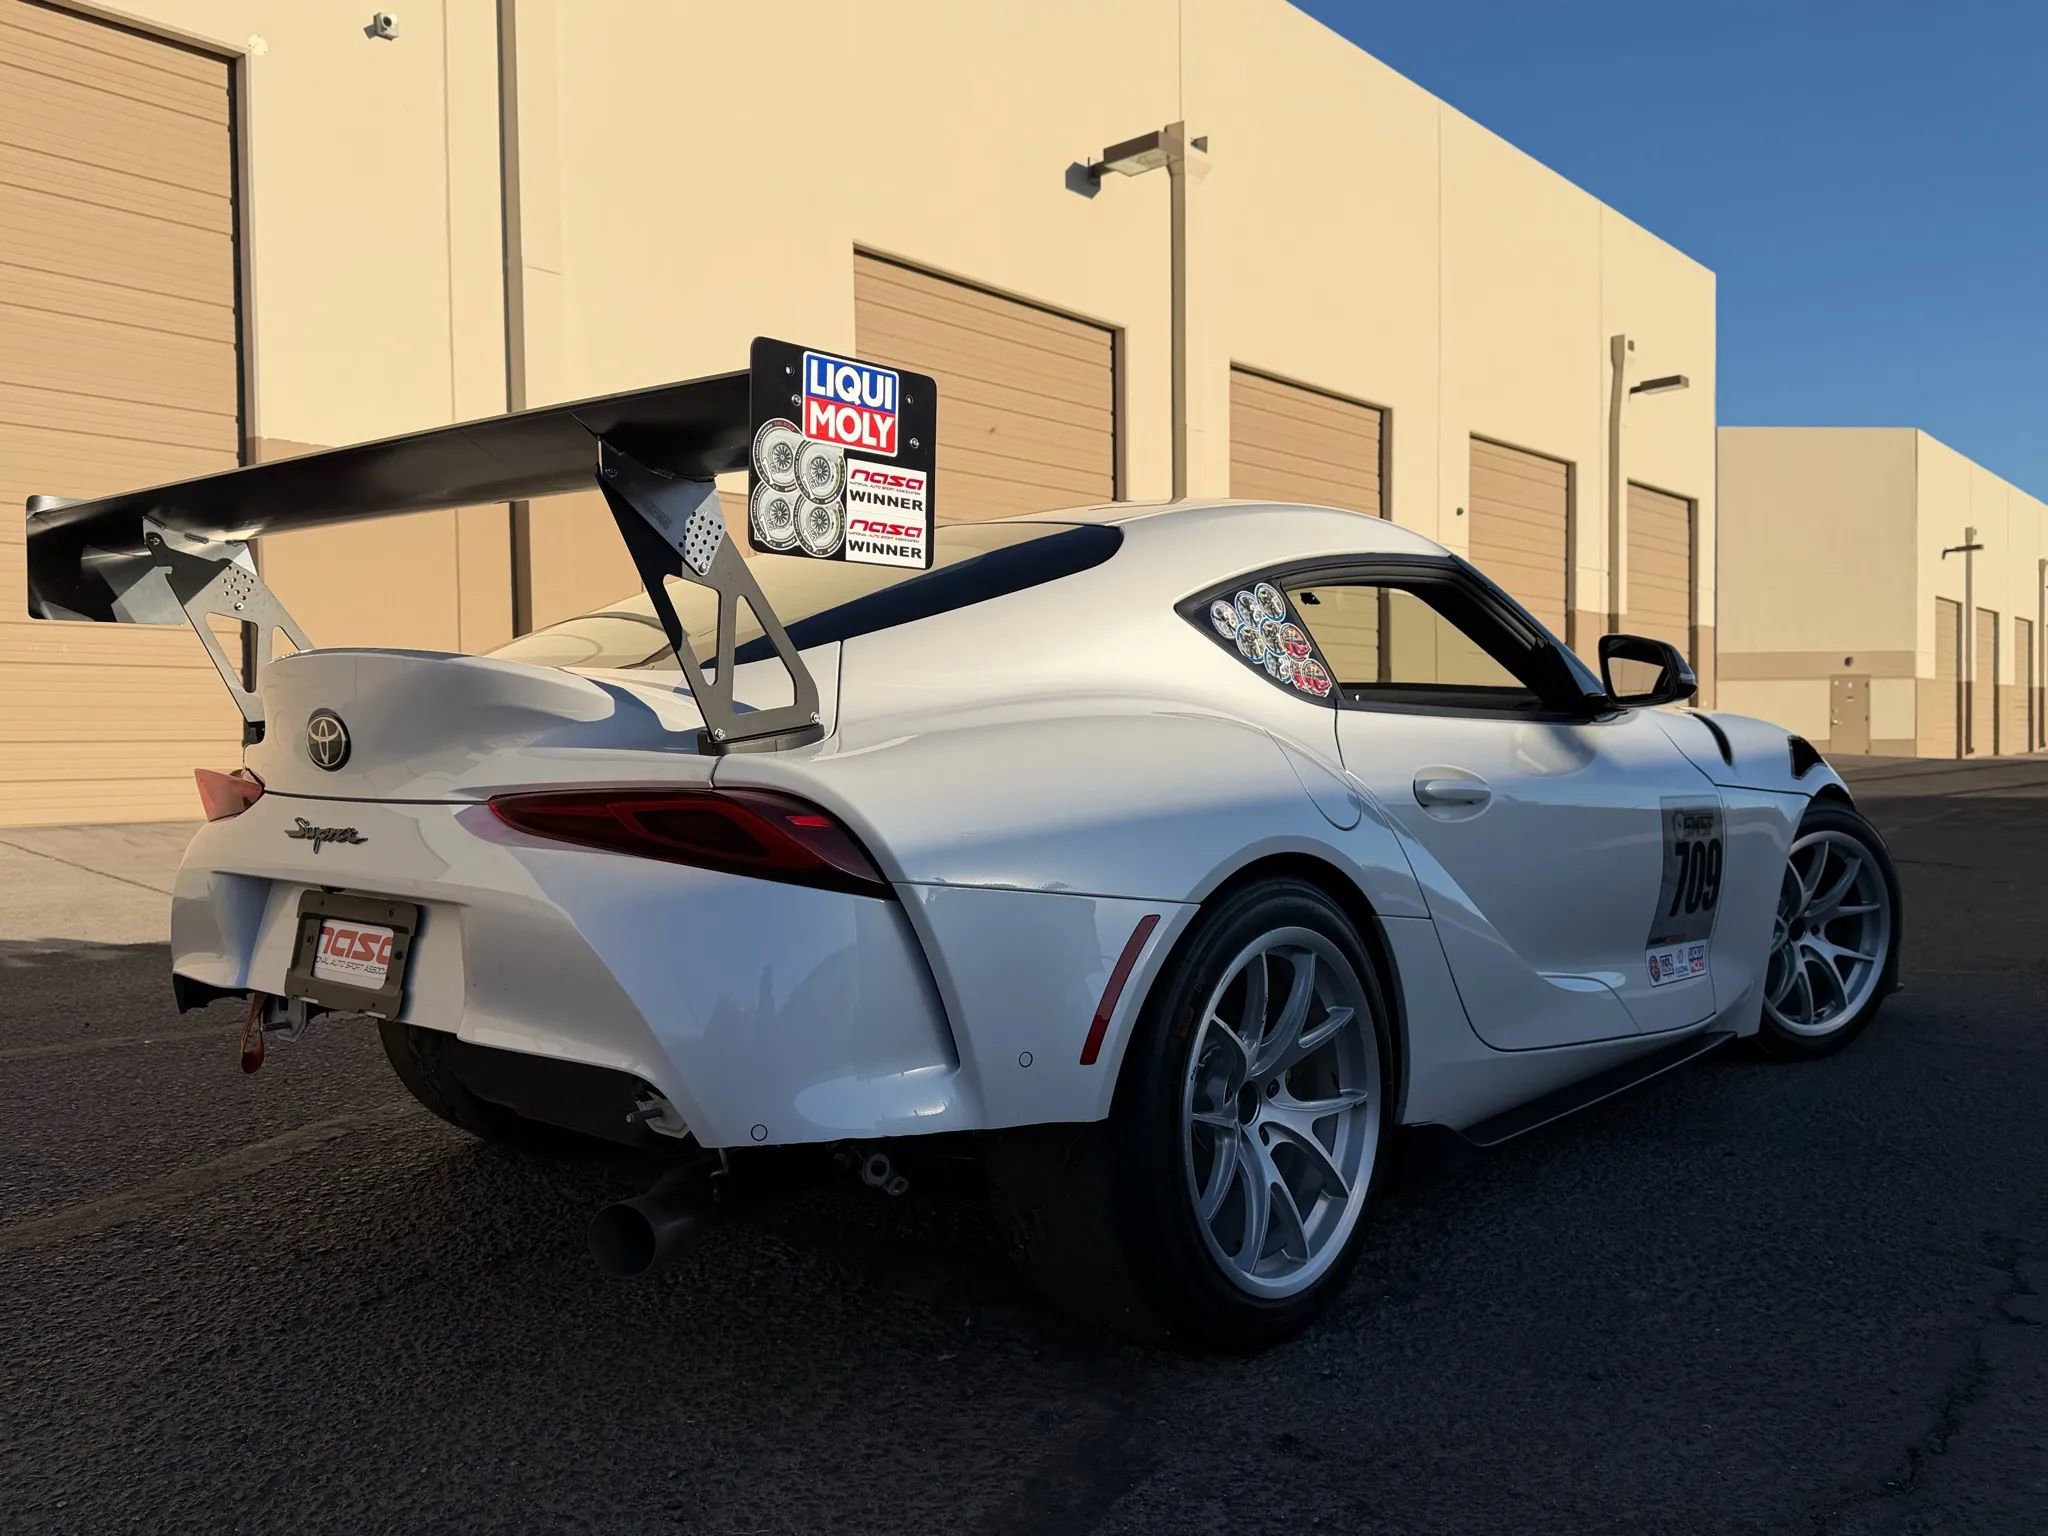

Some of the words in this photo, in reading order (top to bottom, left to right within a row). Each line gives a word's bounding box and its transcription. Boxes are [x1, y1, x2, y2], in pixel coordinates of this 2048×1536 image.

[810, 359, 893, 410] LIQUI
[809, 400, 895, 449] MOLY
[850, 469, 924, 490] nasa
[849, 489, 923, 511] WINNER
[849, 519, 923, 538] nasa
[848, 539, 922, 559] WINNER
[284, 816, 369, 854] Supra
[1669, 838, 1722, 917] 709
[329, 959, 346, 968] AUTO
[345, 961, 365, 971] SPORT
